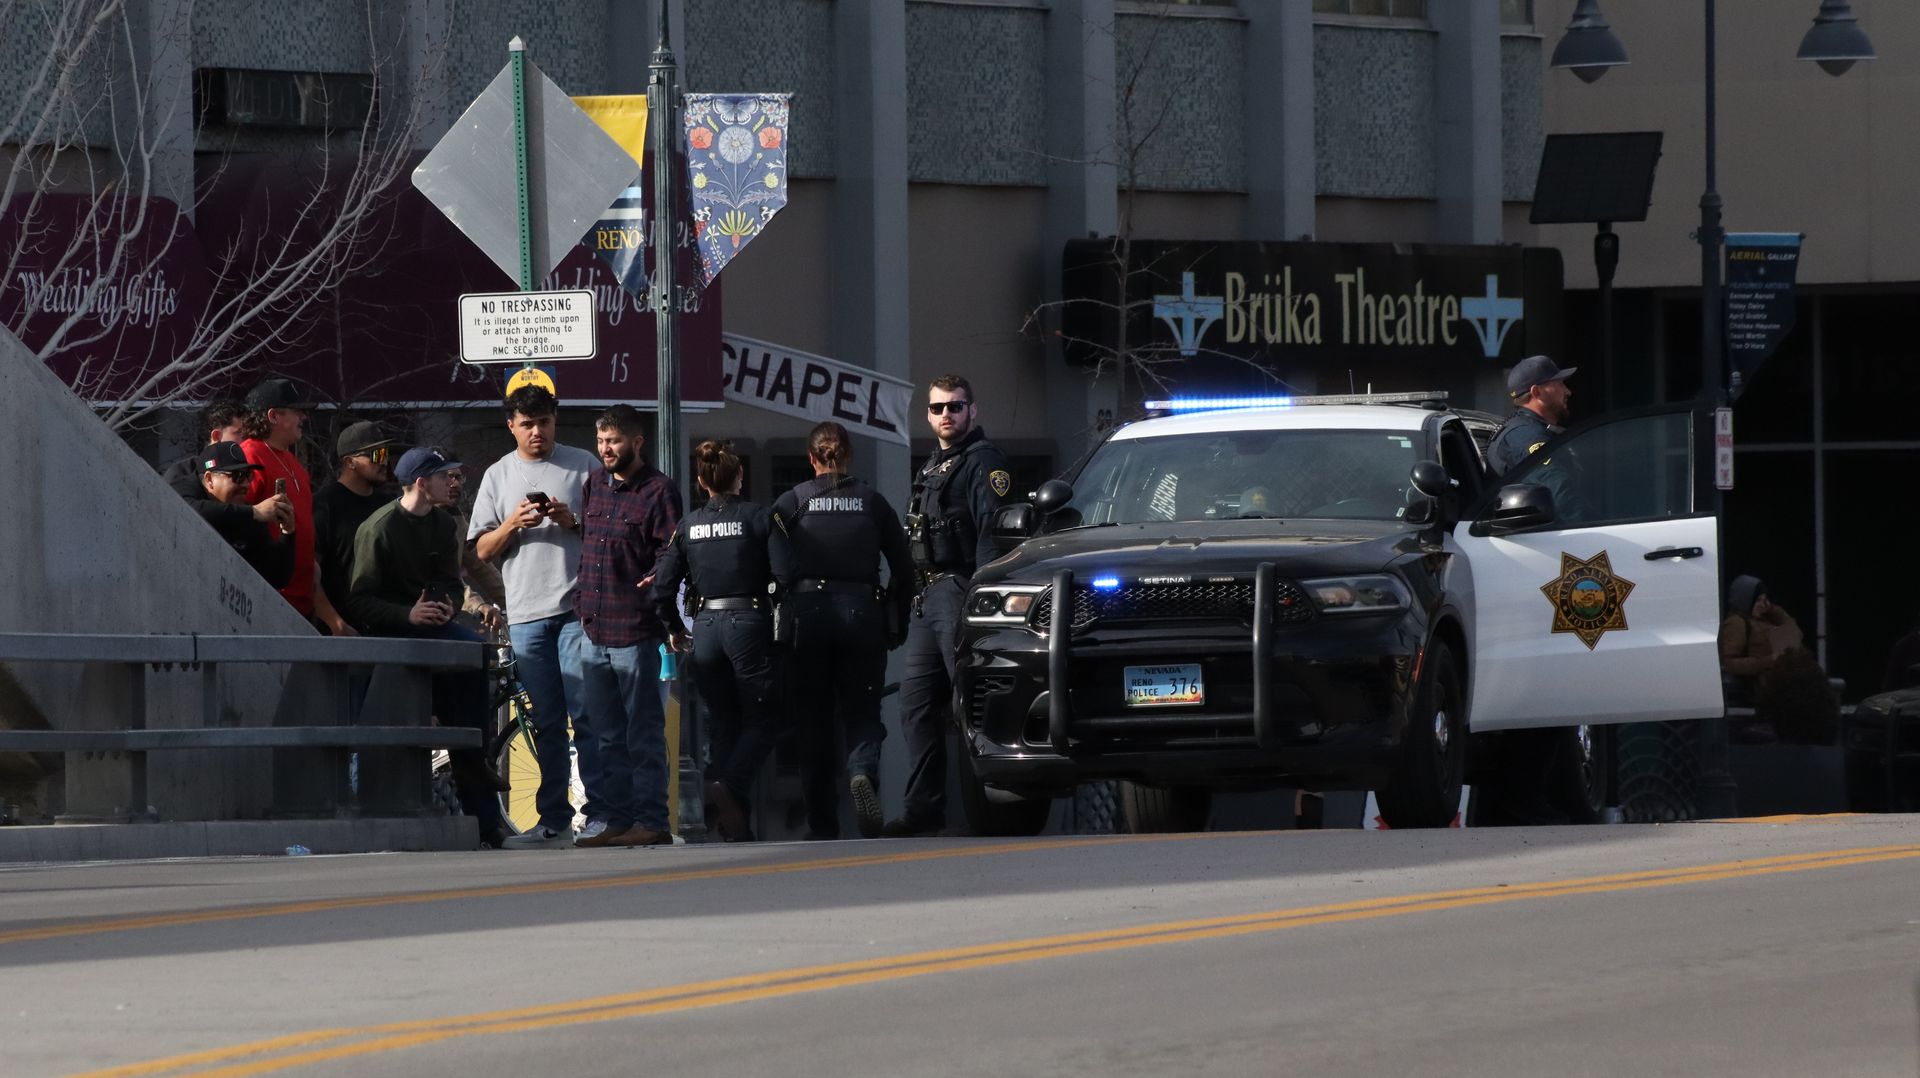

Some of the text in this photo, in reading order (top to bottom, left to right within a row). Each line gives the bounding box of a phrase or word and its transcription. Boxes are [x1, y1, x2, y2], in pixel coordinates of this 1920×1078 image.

[597, 230, 641, 251] RENO
[1730, 250, 1797, 261] AERIAL GALLERY
[16, 267, 178, 329] Wedding Gifts
[1225, 264, 1459, 347] Brüka Theatre
[482, 298, 572, 314] NO TRESPASSING
[474, 315, 580, 328] It is illegal to climb upon
[482, 325, 573, 336] or attach anything to
[506, 335, 550, 347] the bridge.
[492, 346, 509, 355] RMC
[533, 344, 564, 354] 8.10.010
[610, 352, 630, 384] 15
[808, 497, 864, 512] RENO POLICE
[689, 521, 743, 540] RENO POLICE
[1143, 576, 1186, 585] SETINA
[1566, 612, 1609, 630] POLICE
[1144, 666, 1182, 676] NEVADA
[1128, 677, 1199, 697] POLICE 376
[1131, 678, 1153, 687] RENO
